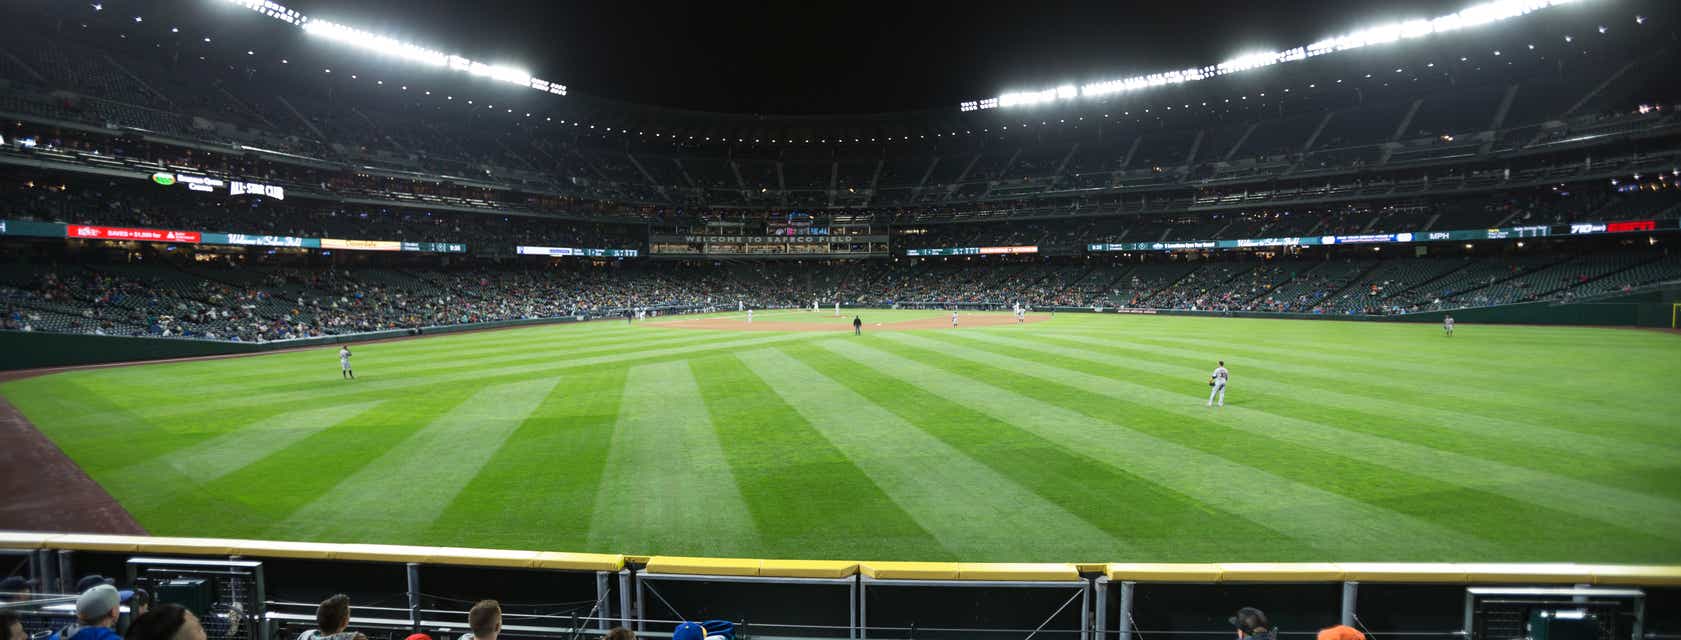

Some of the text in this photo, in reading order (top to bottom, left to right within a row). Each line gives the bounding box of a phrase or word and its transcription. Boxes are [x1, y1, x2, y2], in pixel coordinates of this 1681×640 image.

[265, 185, 284, 201] CLUB
[1607, 221, 1656, 232] ESPN
[819, 235, 853, 243] FIELD
[1428, 232, 1450, 240] MPH
